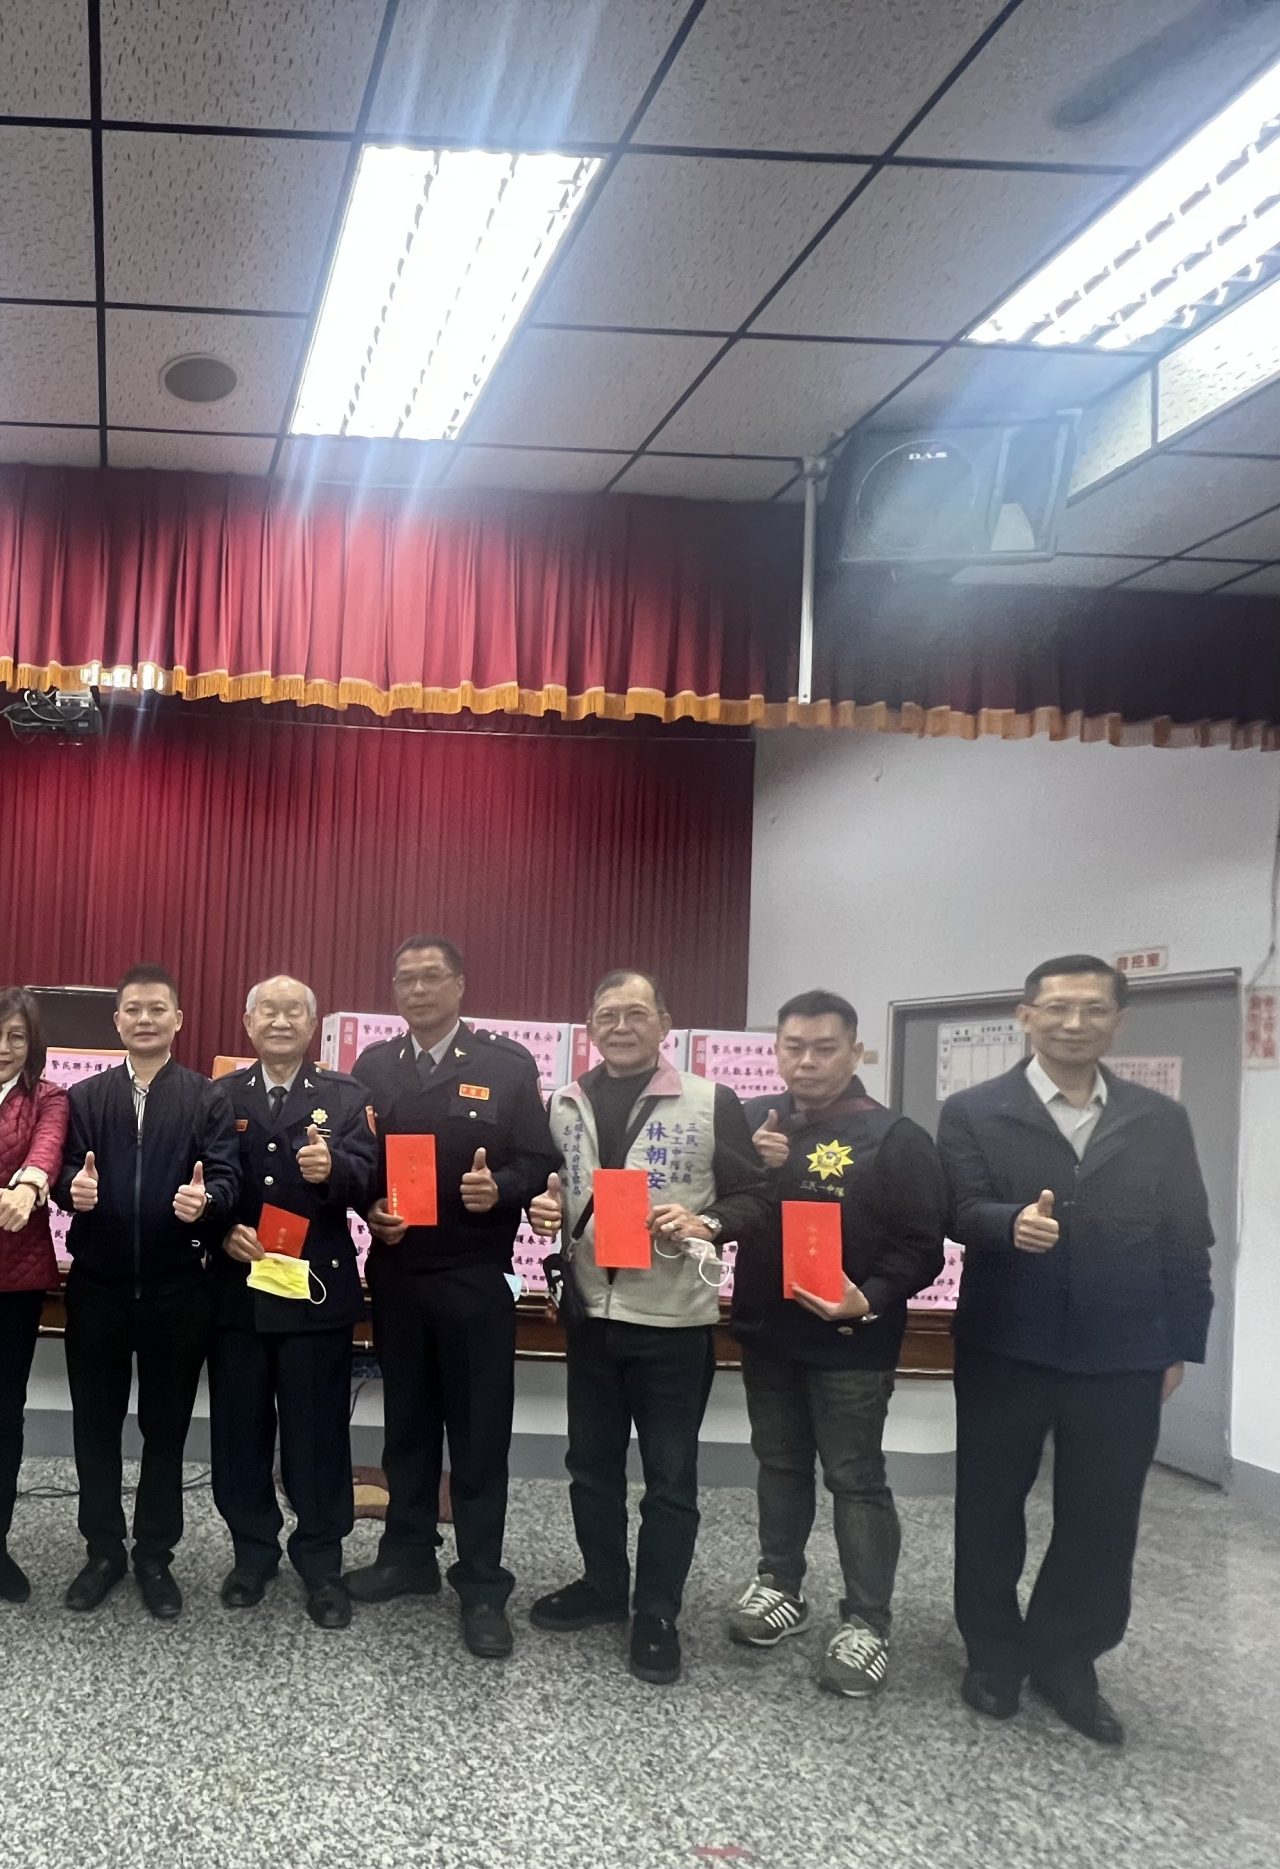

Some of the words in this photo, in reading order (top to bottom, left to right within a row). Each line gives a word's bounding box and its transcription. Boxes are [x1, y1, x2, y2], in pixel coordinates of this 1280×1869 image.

[712, 1067, 780, 1077] 市民歡喜過好
[645, 1121, 669, 1190] 林朝安
